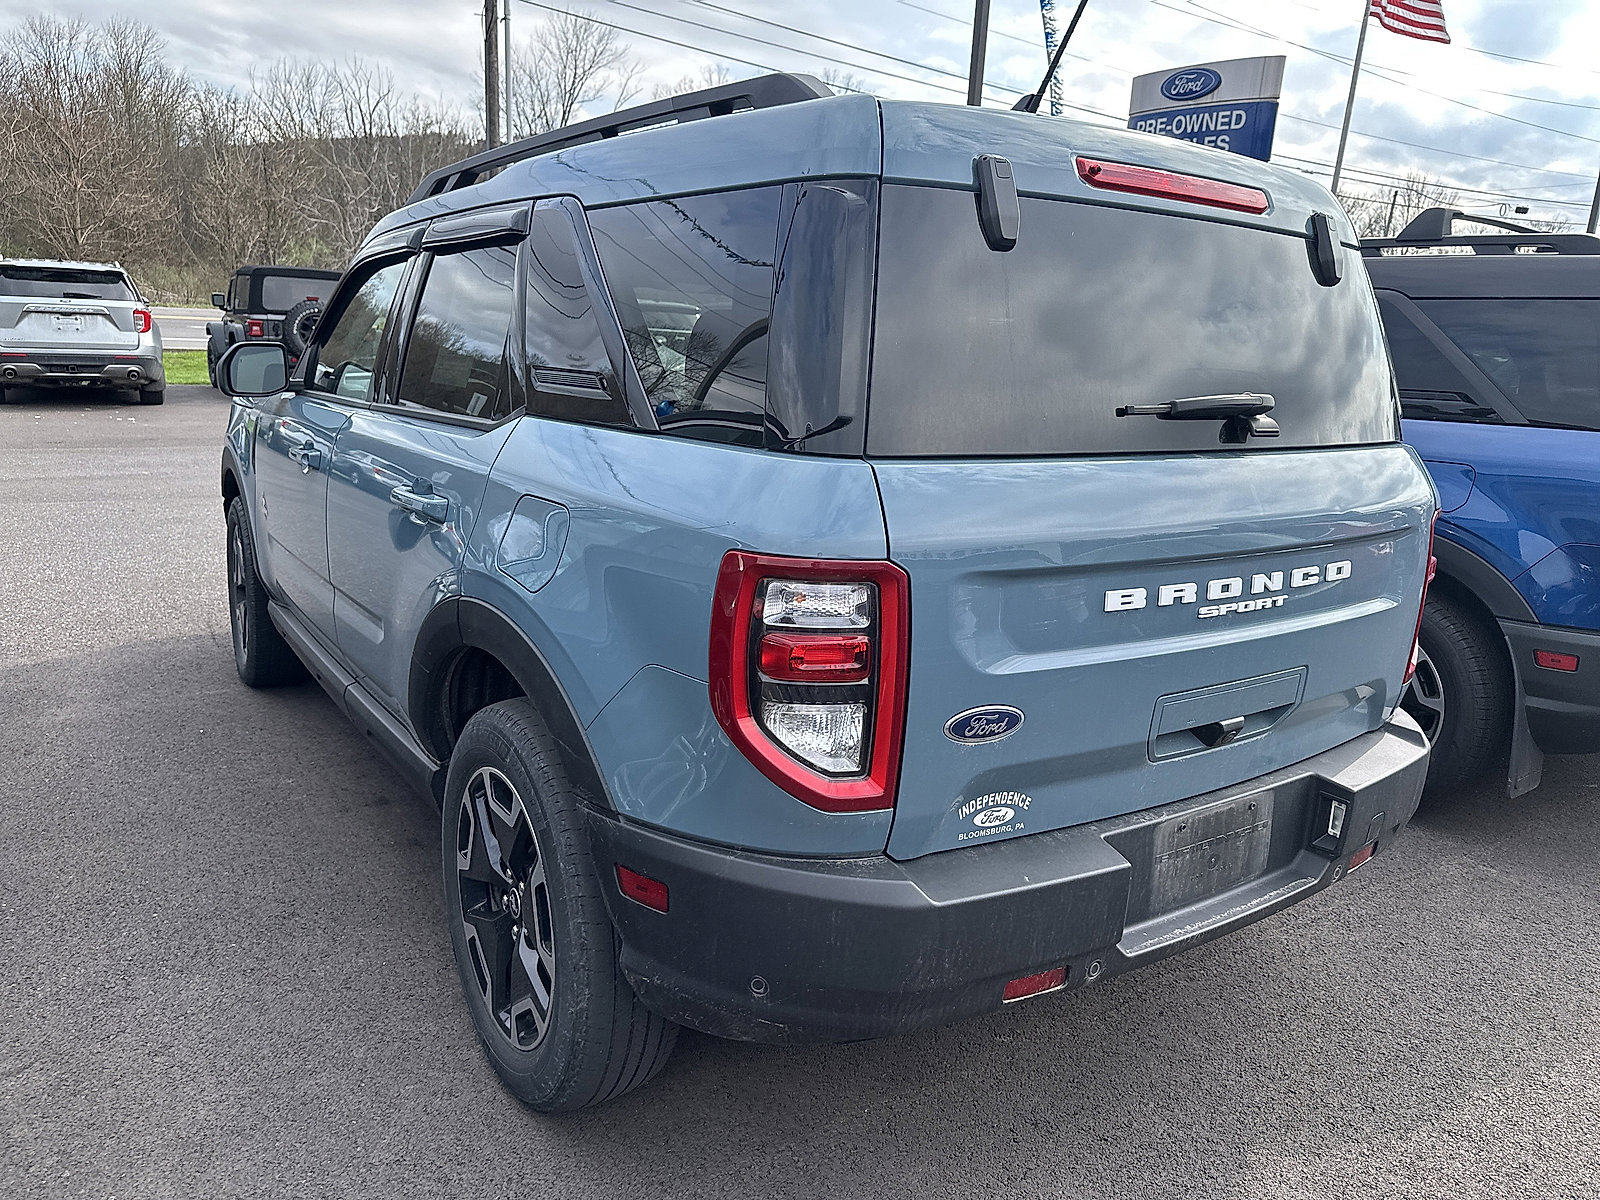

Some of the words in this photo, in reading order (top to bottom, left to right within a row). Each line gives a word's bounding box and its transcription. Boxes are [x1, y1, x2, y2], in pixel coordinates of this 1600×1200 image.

[1170, 73, 1206, 96] Ford
[1136, 110, 1247, 135] PRE-OWNED
[1103, 560, 1352, 613] BRONCO
[1197, 595, 1289, 619] SPORT
[964, 714, 1009, 737] Ford
[957, 791, 1032, 820] INDEPENDENCE
[980, 808, 1009, 825] Ford
[958, 824, 1014, 841] BLOOMSBURG,
[1015, 822, 1025, 831] PA
